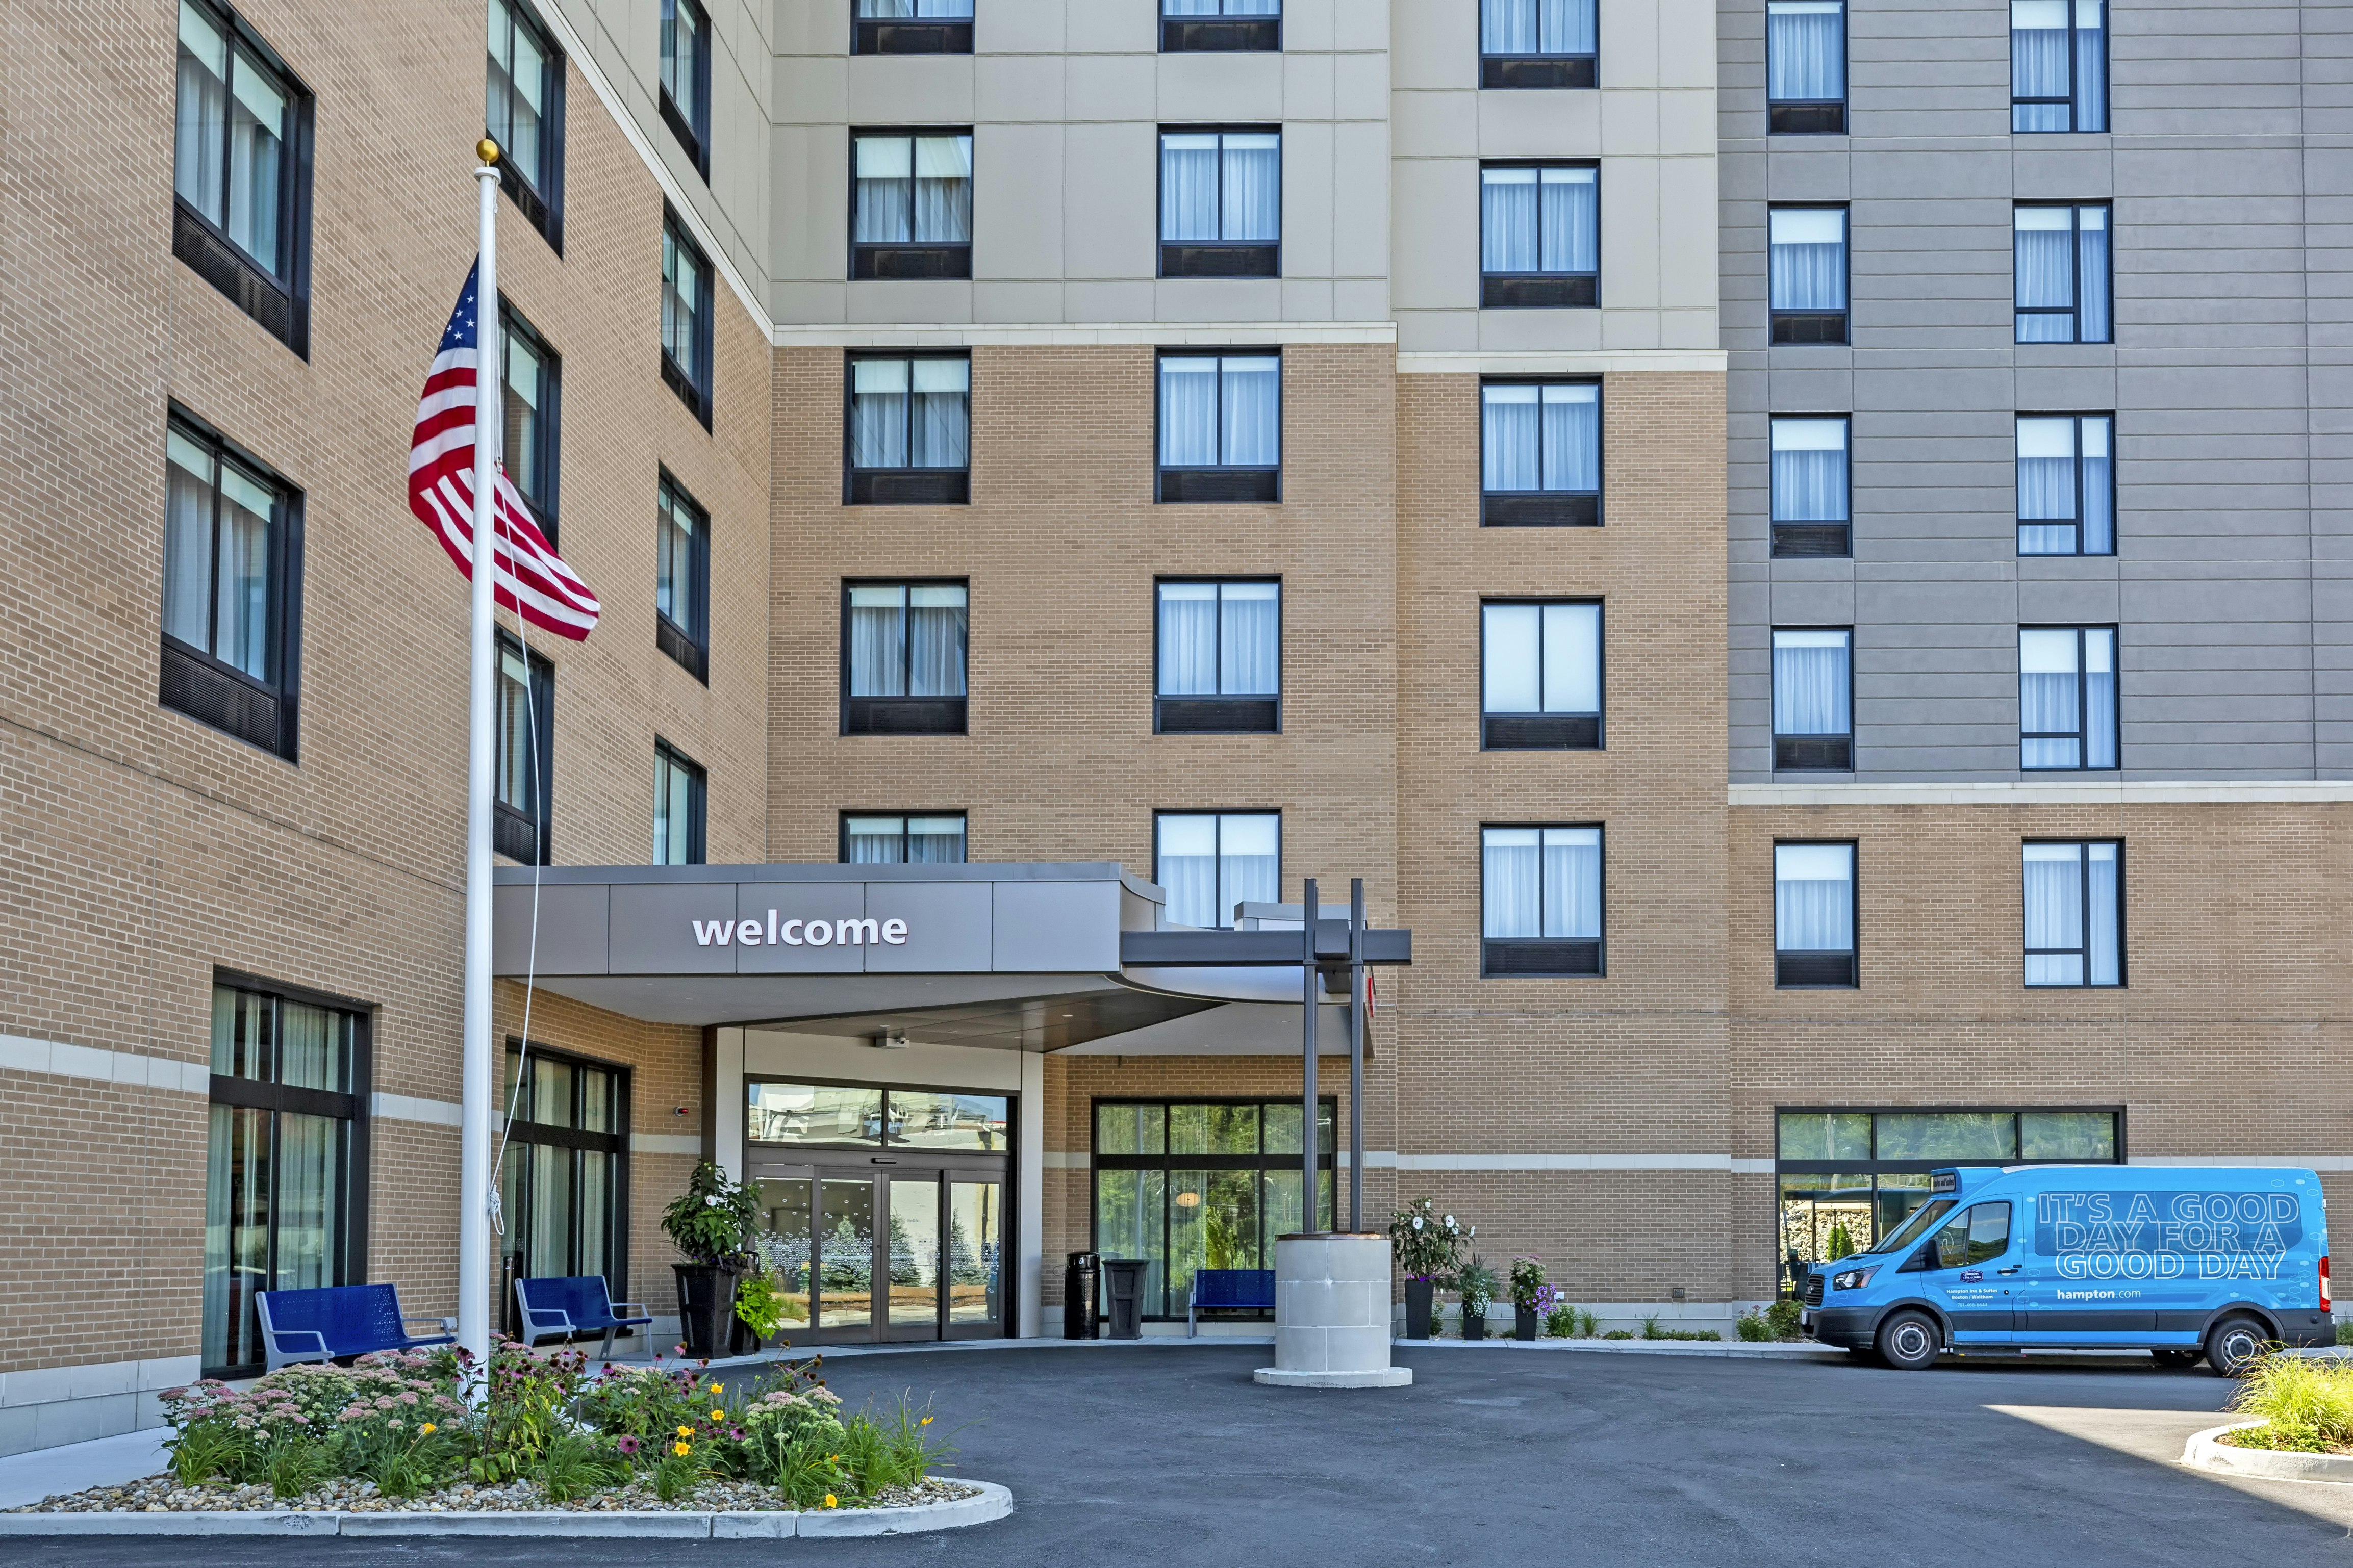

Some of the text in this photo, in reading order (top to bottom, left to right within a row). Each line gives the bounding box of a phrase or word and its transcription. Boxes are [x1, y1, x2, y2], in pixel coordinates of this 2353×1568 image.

[692, 909, 908, 946] welcome
[1945, 1178, 1954, 1186] Suites
[2038, 1193, 2299, 1224] IT'S A GOOD
[2056, 1221, 2286, 1252] DAY FOR A
[2056, 1250, 2287, 1280] GOOD DAY
[2057, 1289, 2141, 1301] hampton.com
